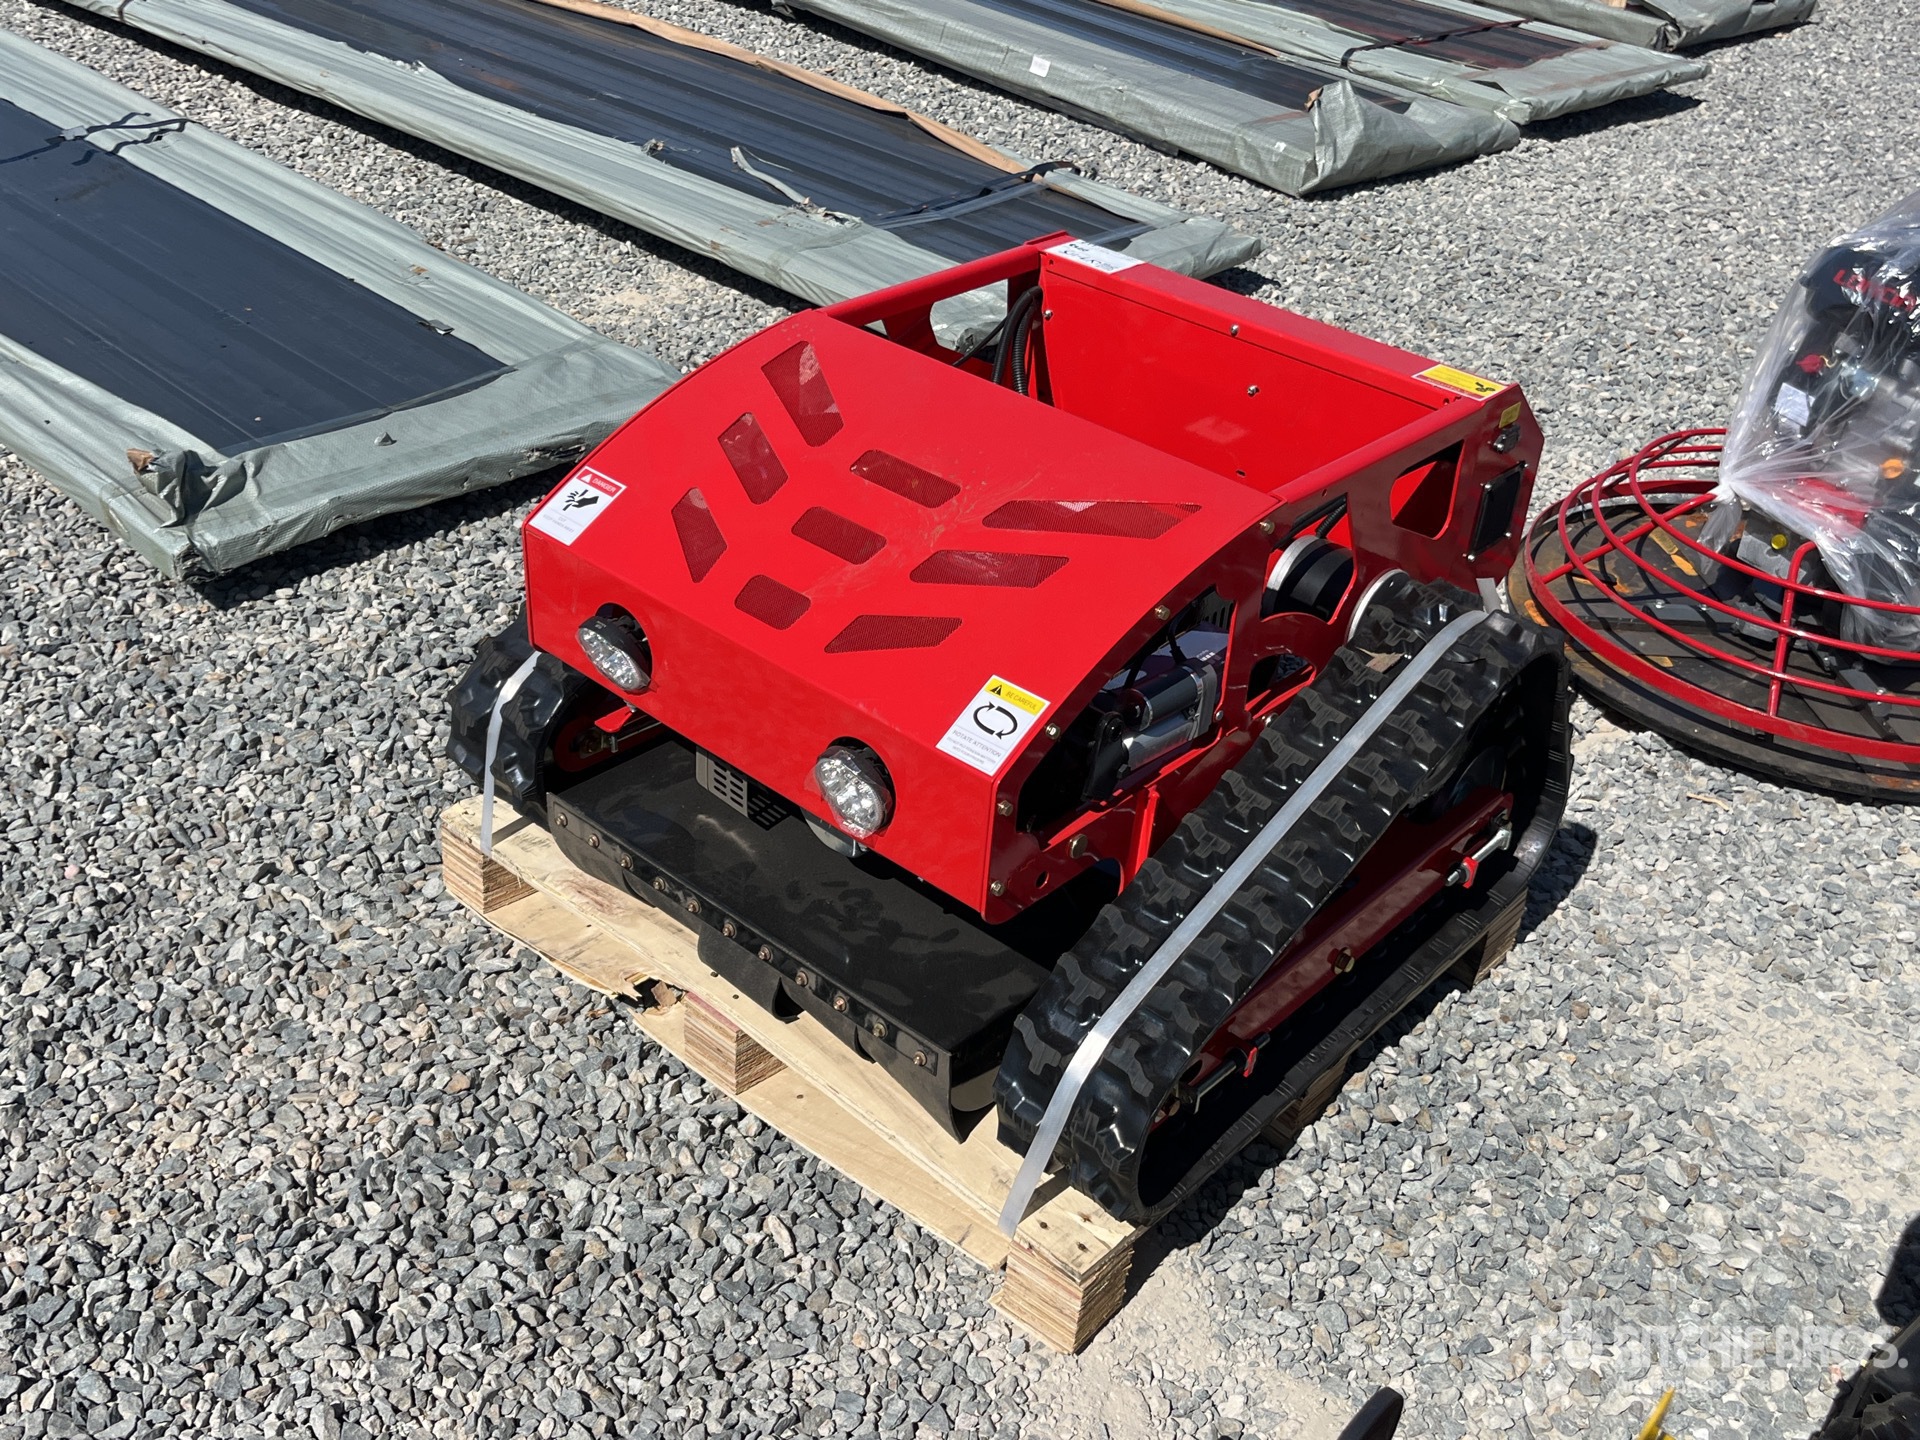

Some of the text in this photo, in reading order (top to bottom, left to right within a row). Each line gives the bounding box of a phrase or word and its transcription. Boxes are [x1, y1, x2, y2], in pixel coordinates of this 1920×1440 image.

[591, 477, 617, 493] DANGER
[1013, 694, 1037, 711] CAREFUL
[952, 729, 973, 744] ROTATE
[972, 740, 1002, 758] ATTENTION
